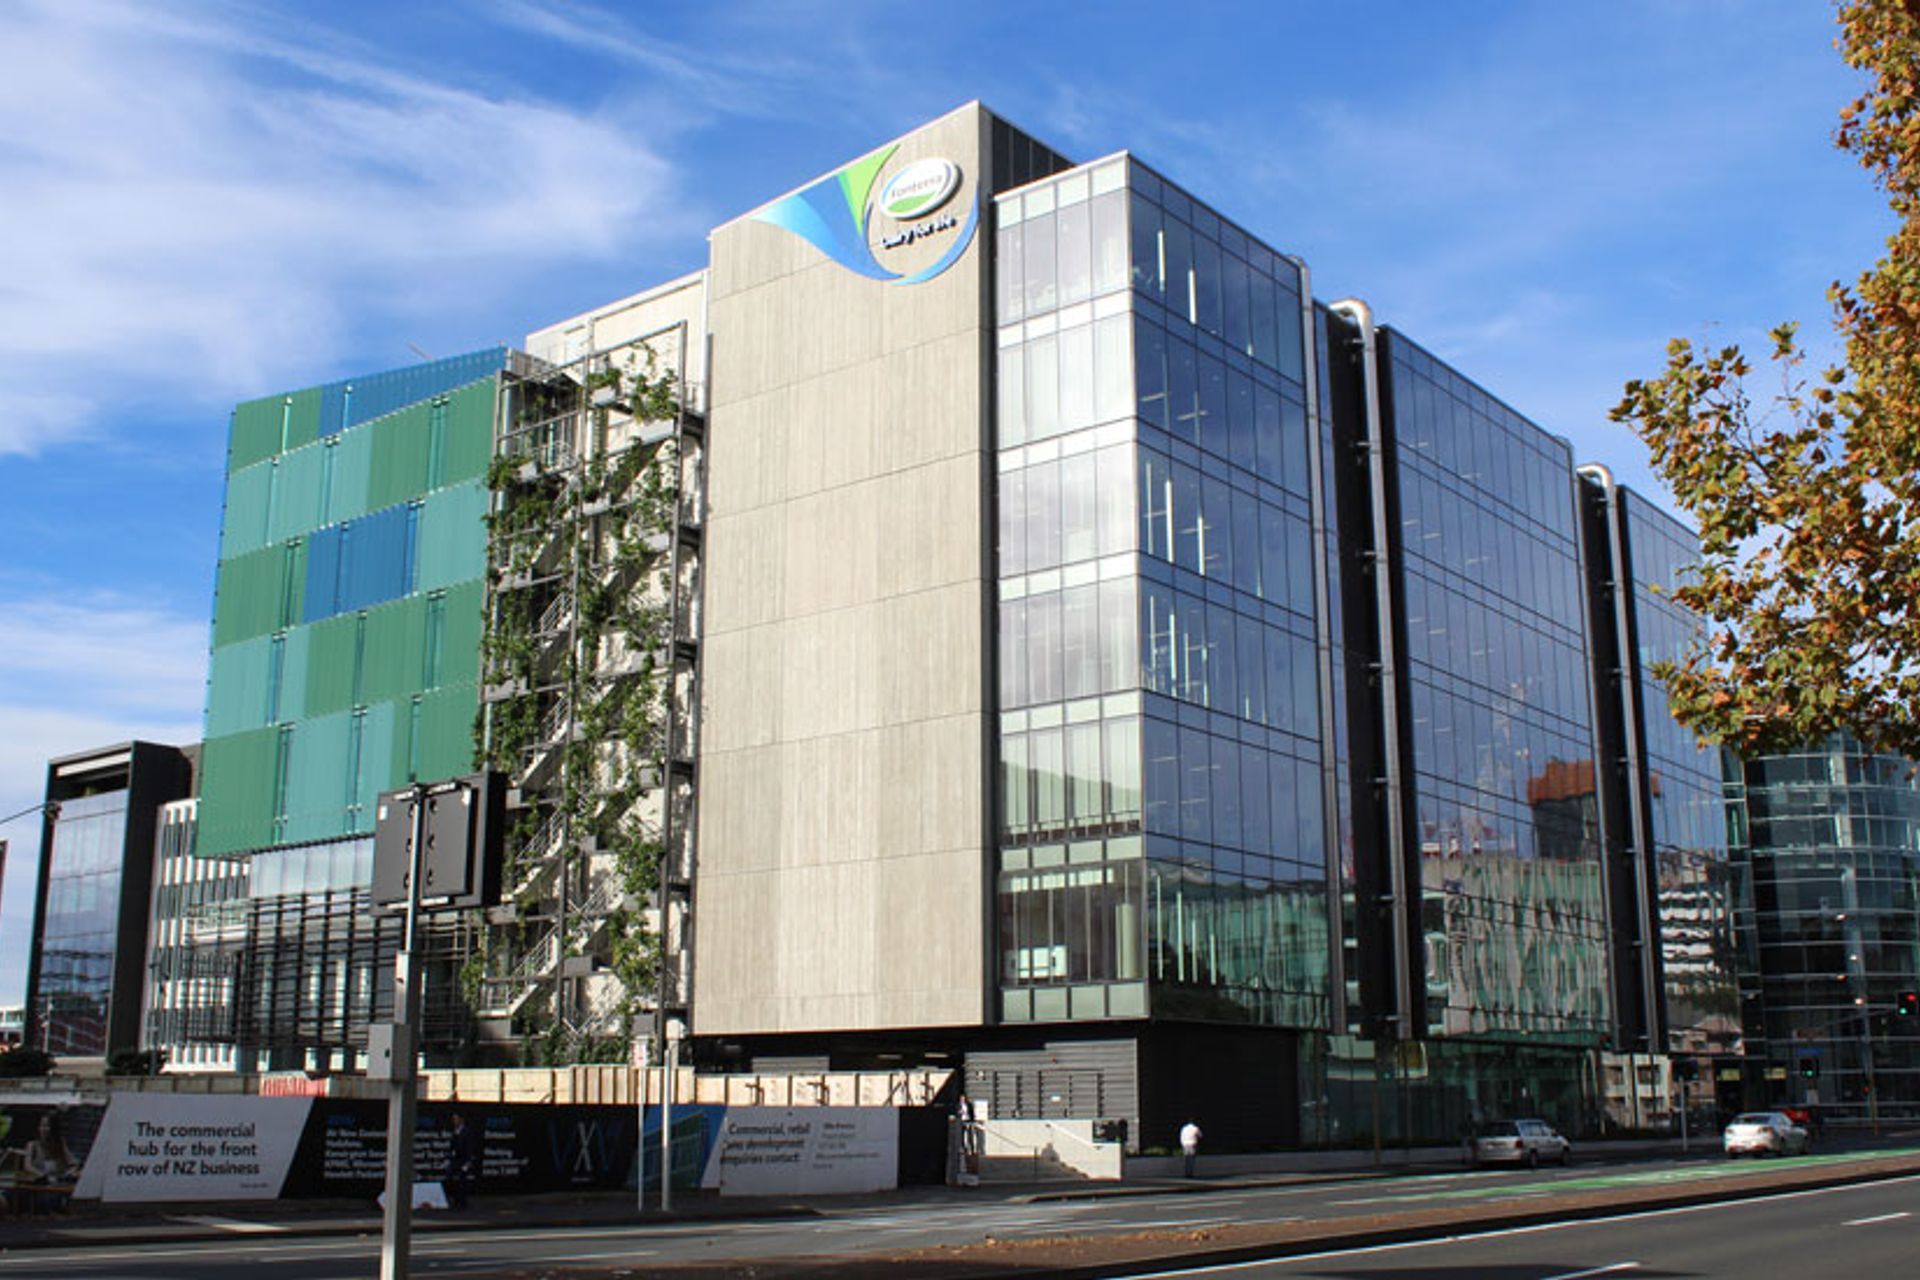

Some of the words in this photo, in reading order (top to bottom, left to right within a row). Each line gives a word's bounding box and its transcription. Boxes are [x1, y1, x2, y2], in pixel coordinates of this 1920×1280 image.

[136, 1121, 165, 1137] The
[170, 1122, 256, 1137] commercial
[128, 1140, 159, 1156] hub
[163, 1141, 186, 1156] for
[191, 1141, 216, 1156] the
[220, 1140, 257, 1156] front
[117, 1163, 149, 1176] row
[152, 1160, 170, 1175] of
[172, 1161, 197, 1175] NZ
[200, 1160, 260, 1175] business
